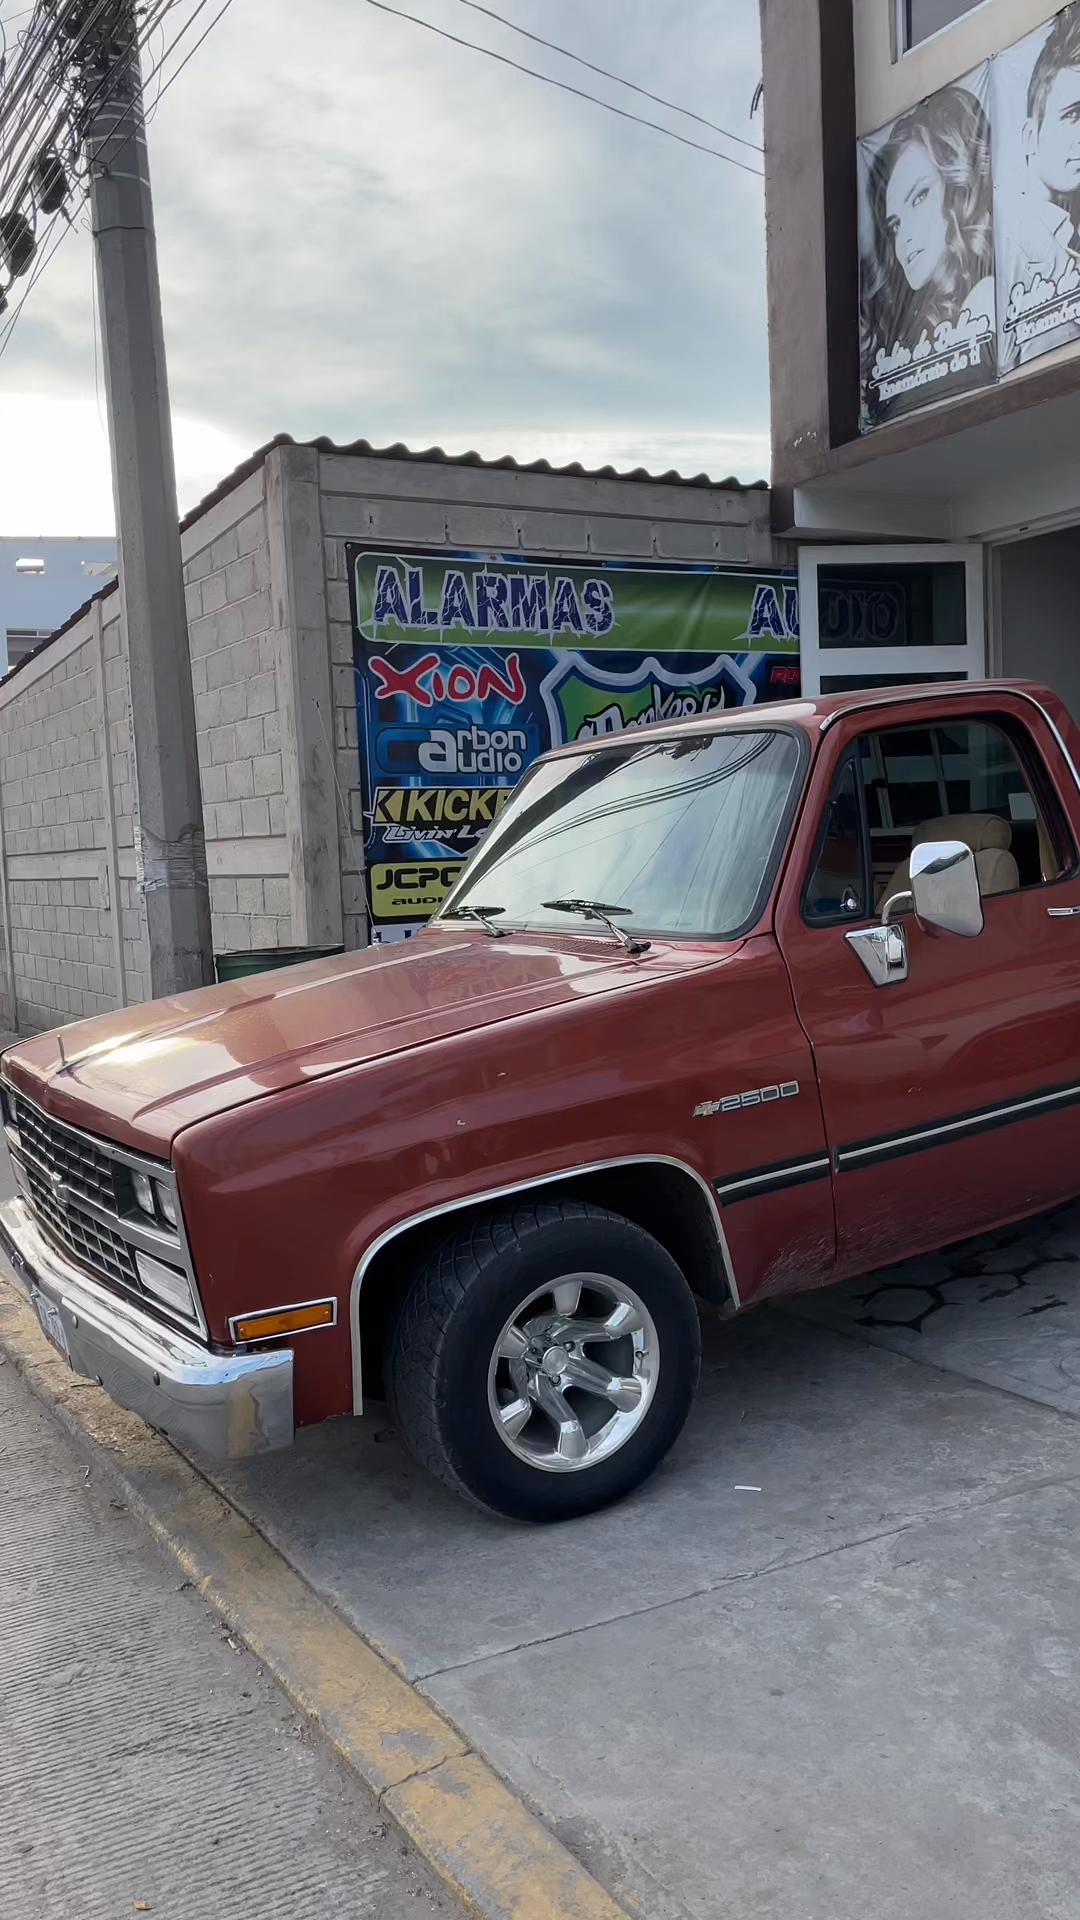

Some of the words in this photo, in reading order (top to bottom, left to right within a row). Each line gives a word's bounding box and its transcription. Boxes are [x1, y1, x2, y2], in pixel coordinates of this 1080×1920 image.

[373, 564, 615, 635] ALARMAS
[368, 653, 527, 706] XION
[719, 1080, 800, 1112] 2500
